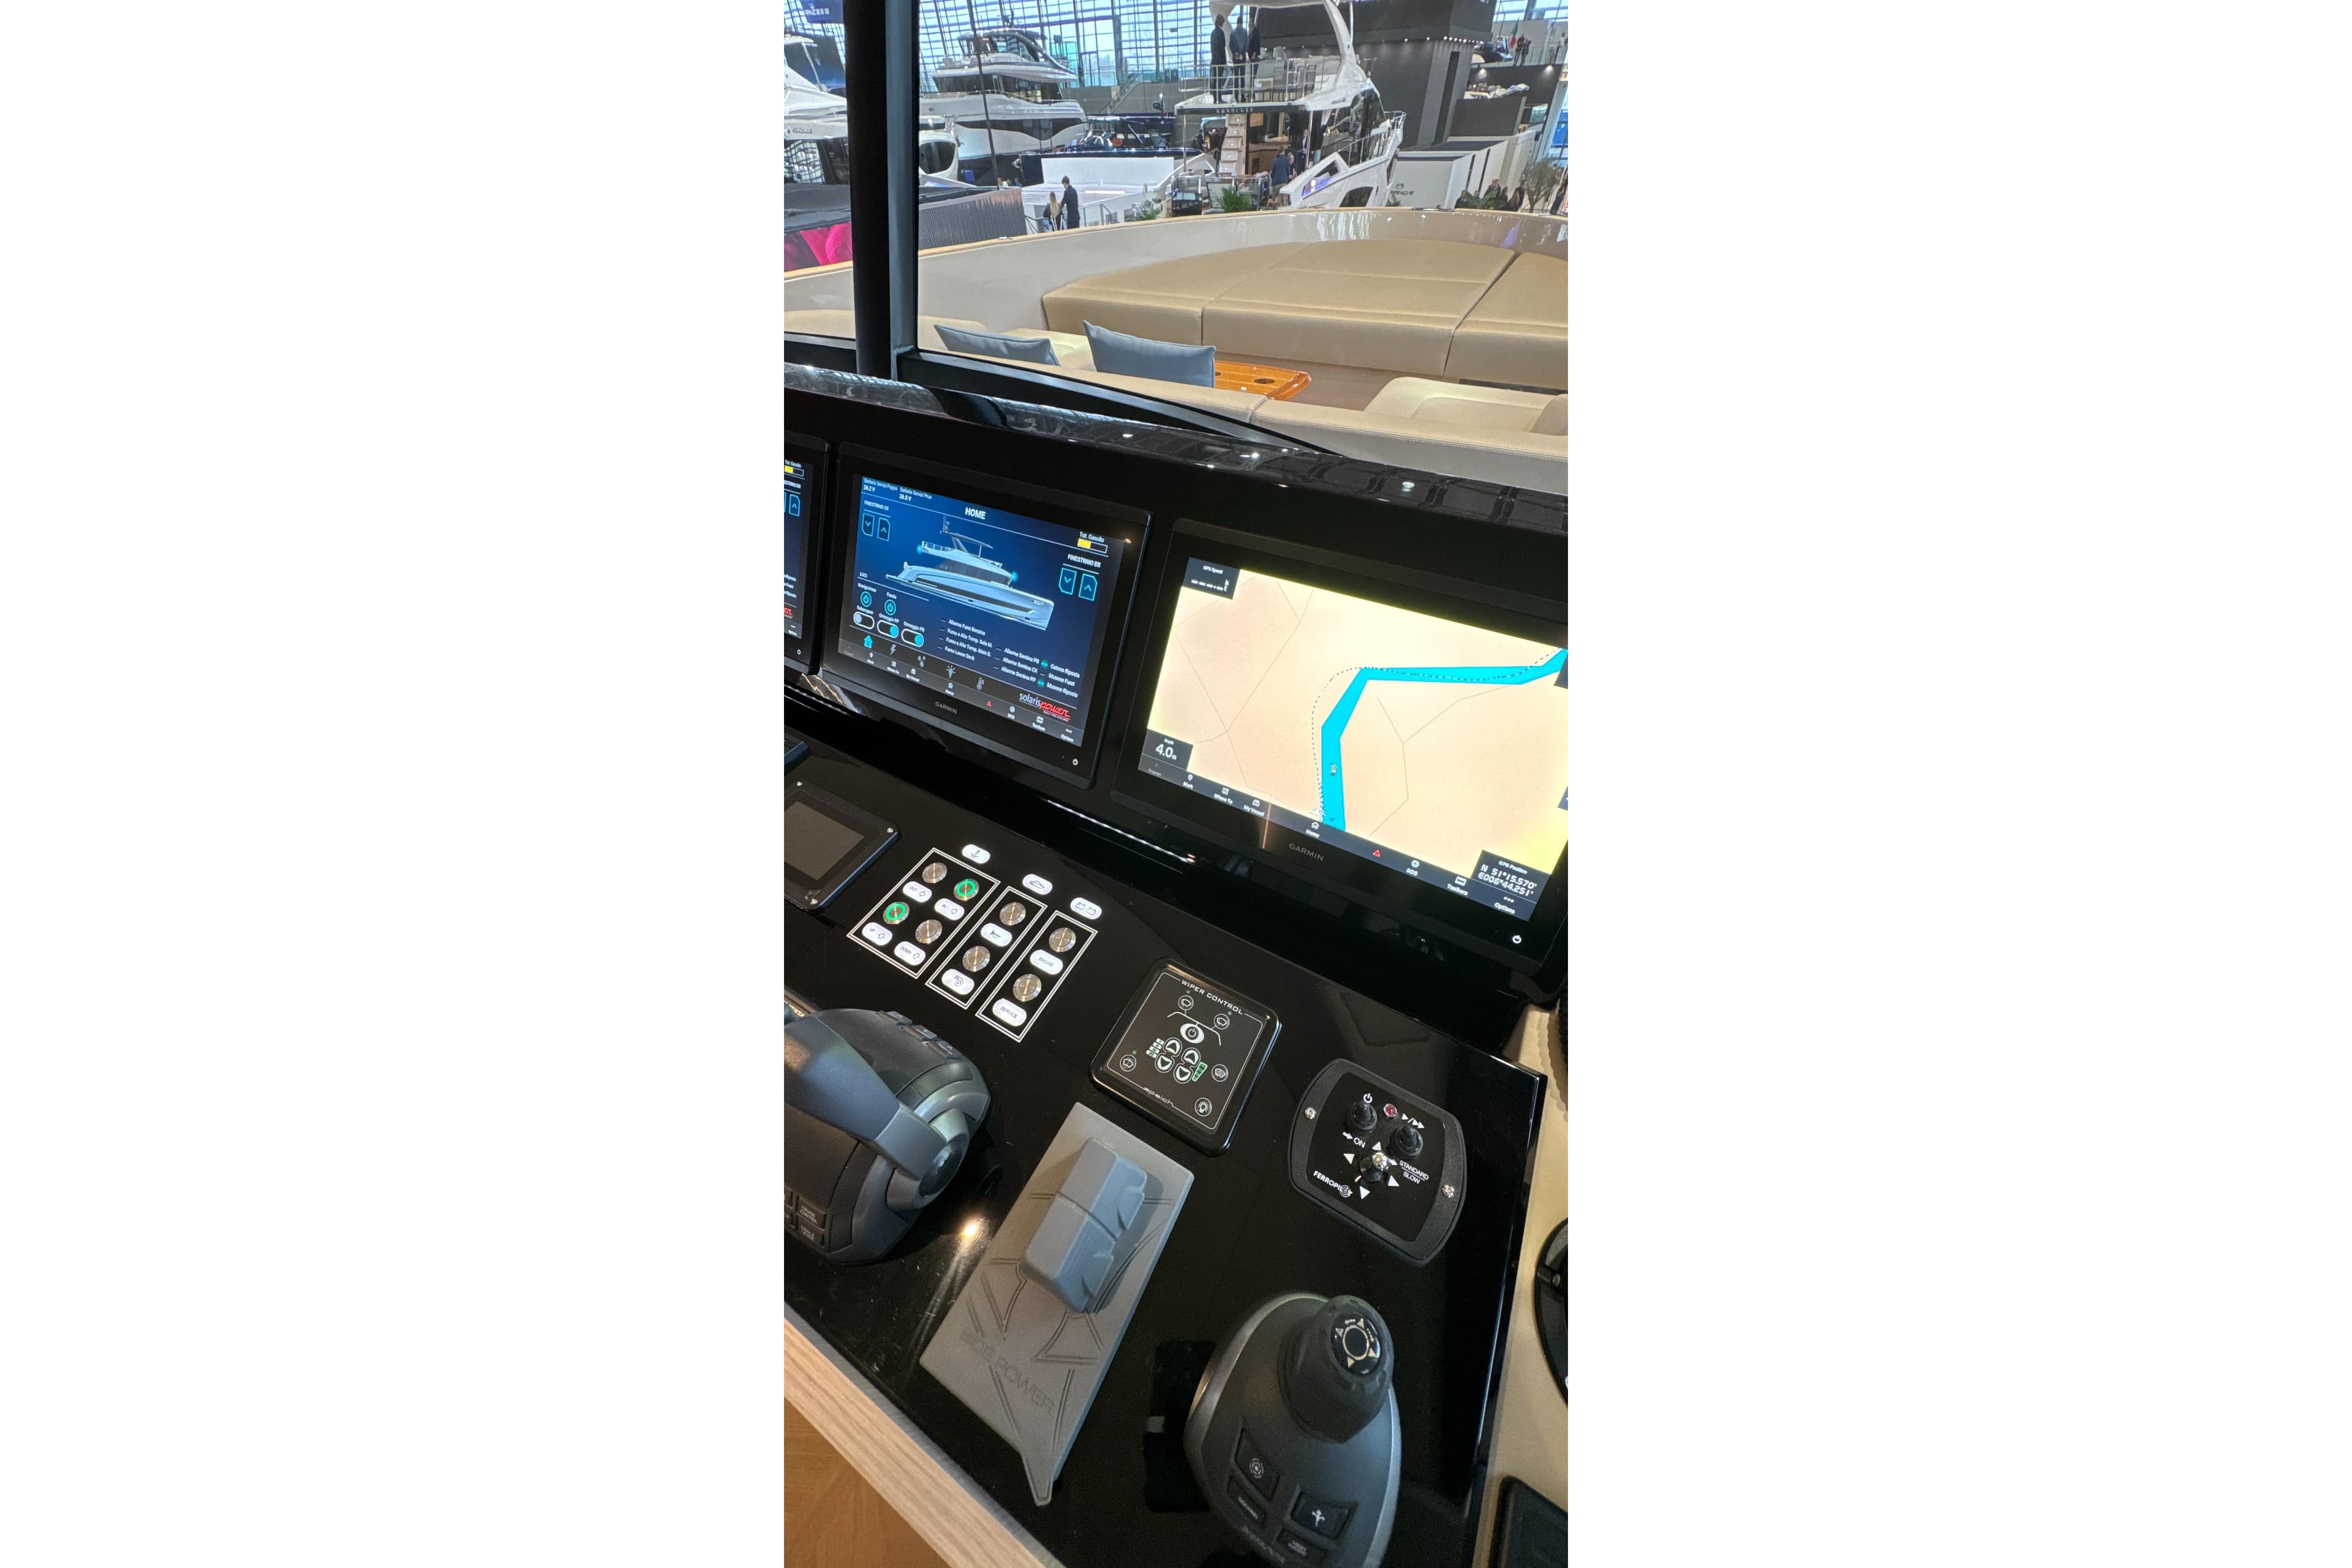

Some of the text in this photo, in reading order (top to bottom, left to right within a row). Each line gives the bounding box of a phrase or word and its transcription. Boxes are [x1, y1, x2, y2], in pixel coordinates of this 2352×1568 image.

[965, 507, 986, 519] HOME
[1088, 533, 1105, 543] Gasolio
[1068, 554, 1094, 566] FINESTRINO
[1005, 648, 1019, 657] Allarme
[1019, 652, 1033, 662] Sentina
[1002, 657, 1017, 666] Allarme
[1017, 662, 1031, 671] Sentina
[1001, 666, 1016, 676] Allarme
[1016, 671, 1030, 680] Sentina
[1050, 663, 1080, 679] Catena Riposto
[1048, 673, 1076, 687] Musone Fuori
[1046, 682, 1078, 698] Musone Riposto
[935, 701, 958, 714] GARMIN
[1148, 767, 1162, 777] Engage
[1183, 781, 1194, 790] Mark
[1214, 793, 1227, 803] Where
[1250, 807, 1265, 816] Vessel
[1306, 829, 1320, 839] Home
[1289, 843, 1324, 861] GARMIN
[1406, 868, 1419, 876] SOS
[1480, 864, 1488, 873] N
[1509, 864, 1528, 875] Position
[1447, 883, 1468, 896] Toolbars
[1494, 902, 1515, 914] Options
[900, 946, 913, 956] DOWN
[1038, 957, 1054, 968] ENGINE
[1181, 979, 1243, 1015] WIPER CONTROL
[1000, 1006, 1018, 1019] SERVICE
[1353, 1137, 1366, 1148] ON
[1399, 1160, 1430, 1181] STANDARD
[1313, 1170, 1353, 1198] FERROPILOT
[1403, 1171, 1421, 1185] SLOW
[800, 1209, 818, 1225] CONTROL
[801, 1205, 816, 1218] CRUISE
[995, 1355, 1057, 1416] POWER
